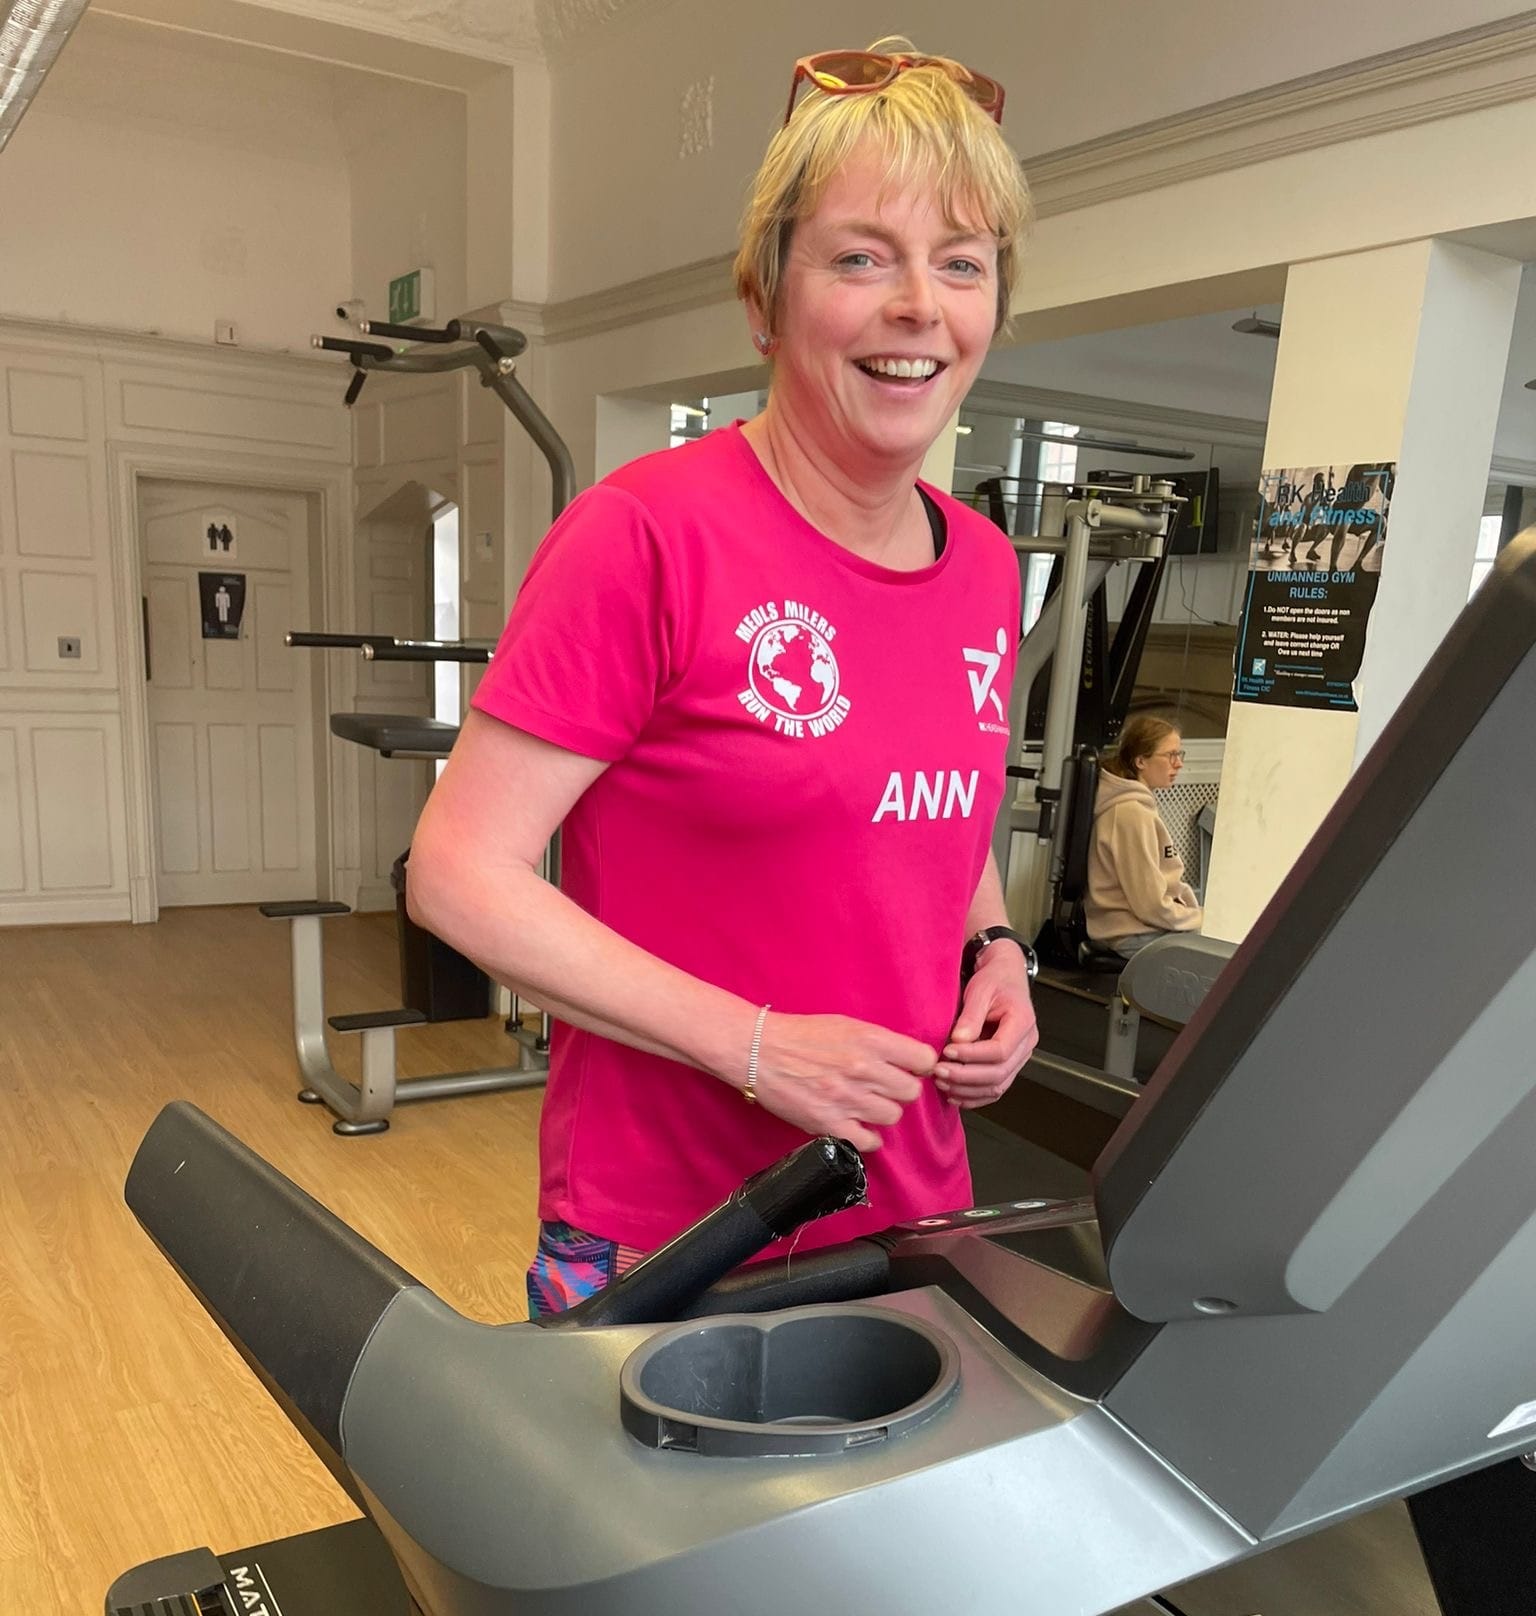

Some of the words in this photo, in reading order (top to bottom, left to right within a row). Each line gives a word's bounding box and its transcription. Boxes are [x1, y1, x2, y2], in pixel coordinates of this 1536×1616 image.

[1277, 483, 1305, 505] RK
[1311, 481, 1370, 504] Health
[1269, 505, 1305, 526] and
[1309, 505, 1377, 527] Fitness
[1267, 571, 1329, 583] UNMANNED
[1331, 571, 1356, 583] GYM
[1289, 587, 1328, 599] RULES:
[1314, 607, 1330, 615] doors
[735, 601, 779, 644] MEOLS
[784, 600, 837, 642] MILERS
[1290, 632, 1308, 640] Please
[1309, 632, 1321, 641] help
[1322, 634, 1345, 642] yourself
[1310, 642, 1329, 650] change
[1330, 642, 1340, 650] OR
[737, 688, 772, 723] RUN
[774, 714, 804, 738] THE
[807, 694, 851, 738] WORLD
[871, 770, 979, 822] ANN
